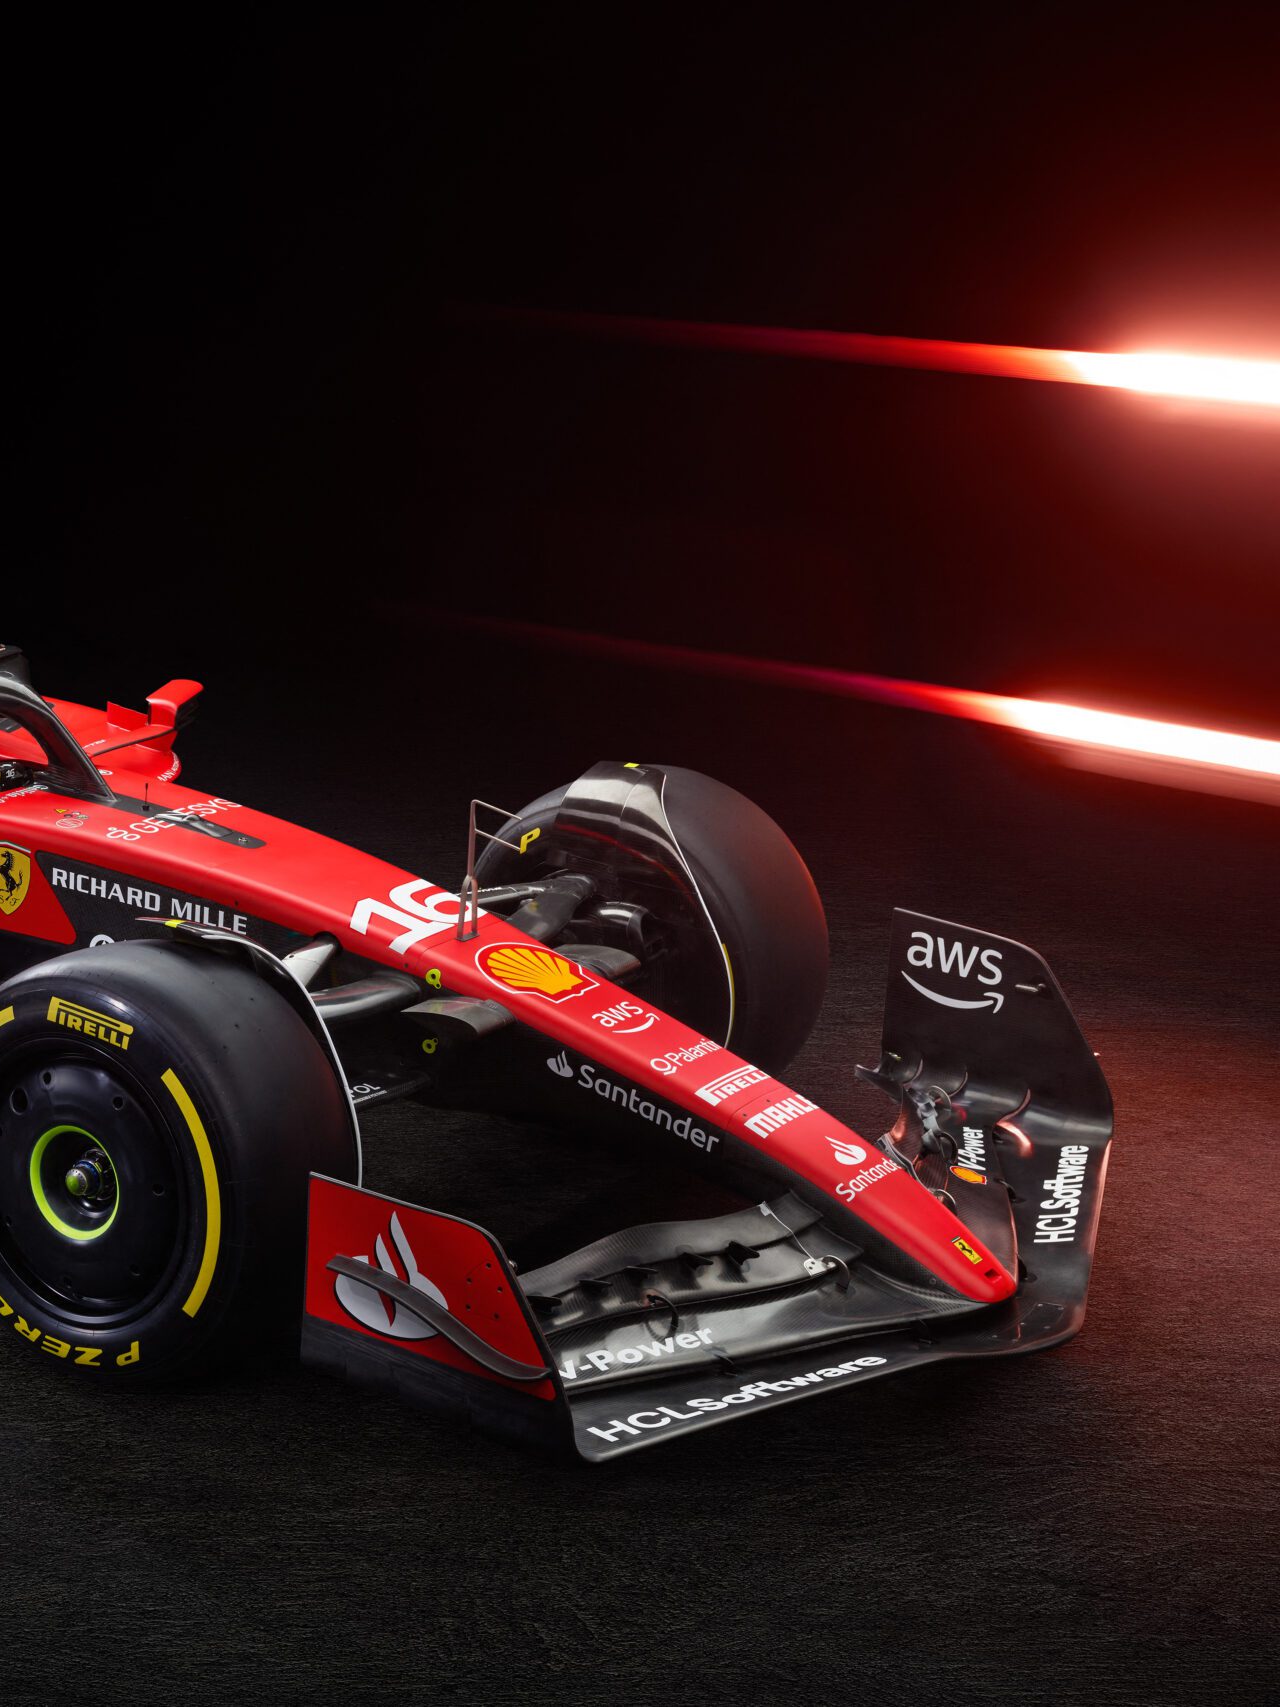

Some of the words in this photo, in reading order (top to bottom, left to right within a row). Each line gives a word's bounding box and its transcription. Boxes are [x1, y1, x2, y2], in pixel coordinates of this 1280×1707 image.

[52, 867, 161, 912] RICHARD
[171, 898, 248, 935] MILLE
[350, 878, 488, 955] 16
[907, 931, 1003, 986] aws
[47, 996, 133, 1050] PIRELLI
[592, 1001, 644, 1028] aws
[579, 1064, 719, 1153] Santander
[694, 1065, 771, 1107] PIRELL
[958, 1126, 986, 1171] V-Power
[1033, 1145, 1089, 1244] HCLSoftware
[116, 1340, 140, 1367] P
[586, 1356, 888, 1442] HCLSoftware
